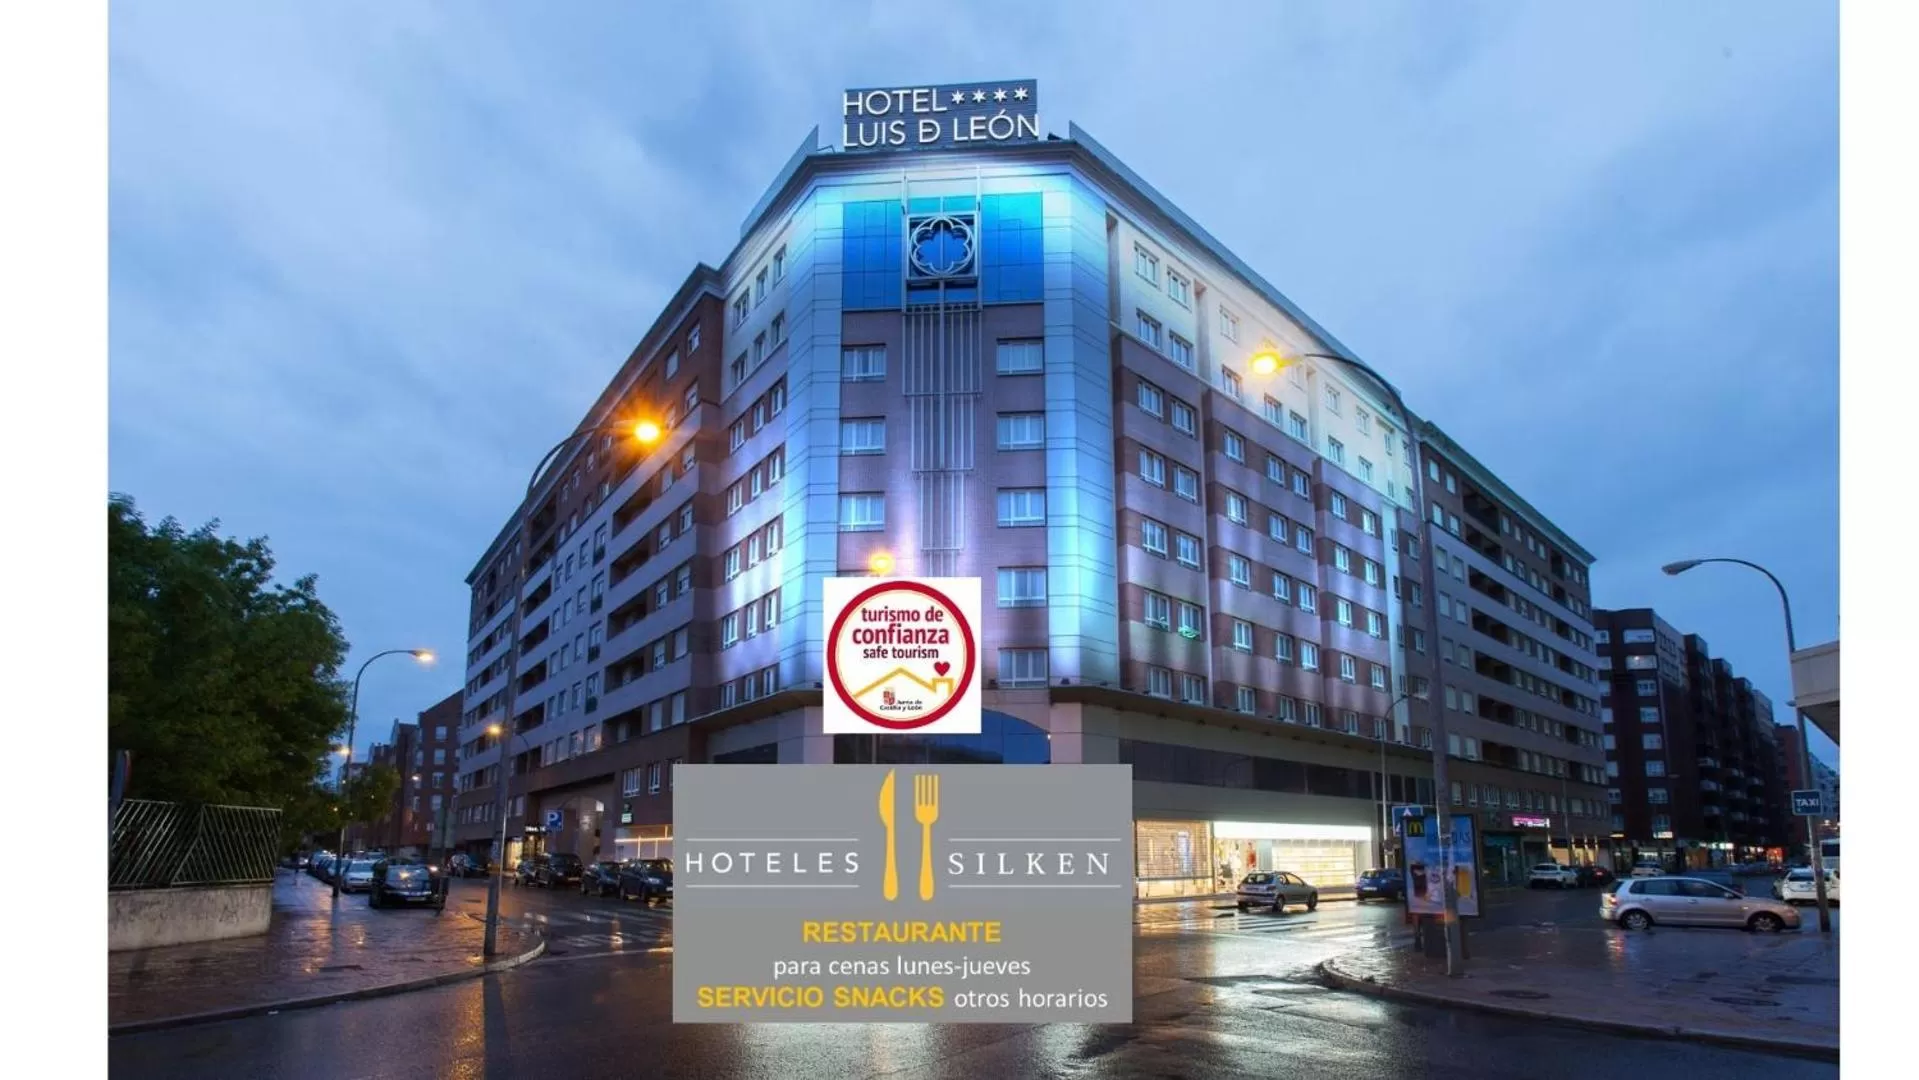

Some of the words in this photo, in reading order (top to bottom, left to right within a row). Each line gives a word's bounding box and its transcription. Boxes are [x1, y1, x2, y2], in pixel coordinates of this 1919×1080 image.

[843, 88, 948, 116] HOTEL
[843, 121, 906, 147] LUIS
[953, 109, 1040, 142] LEÓN
[1795, 798, 1820, 807] TAXI
[547, 811, 559, 826] P
